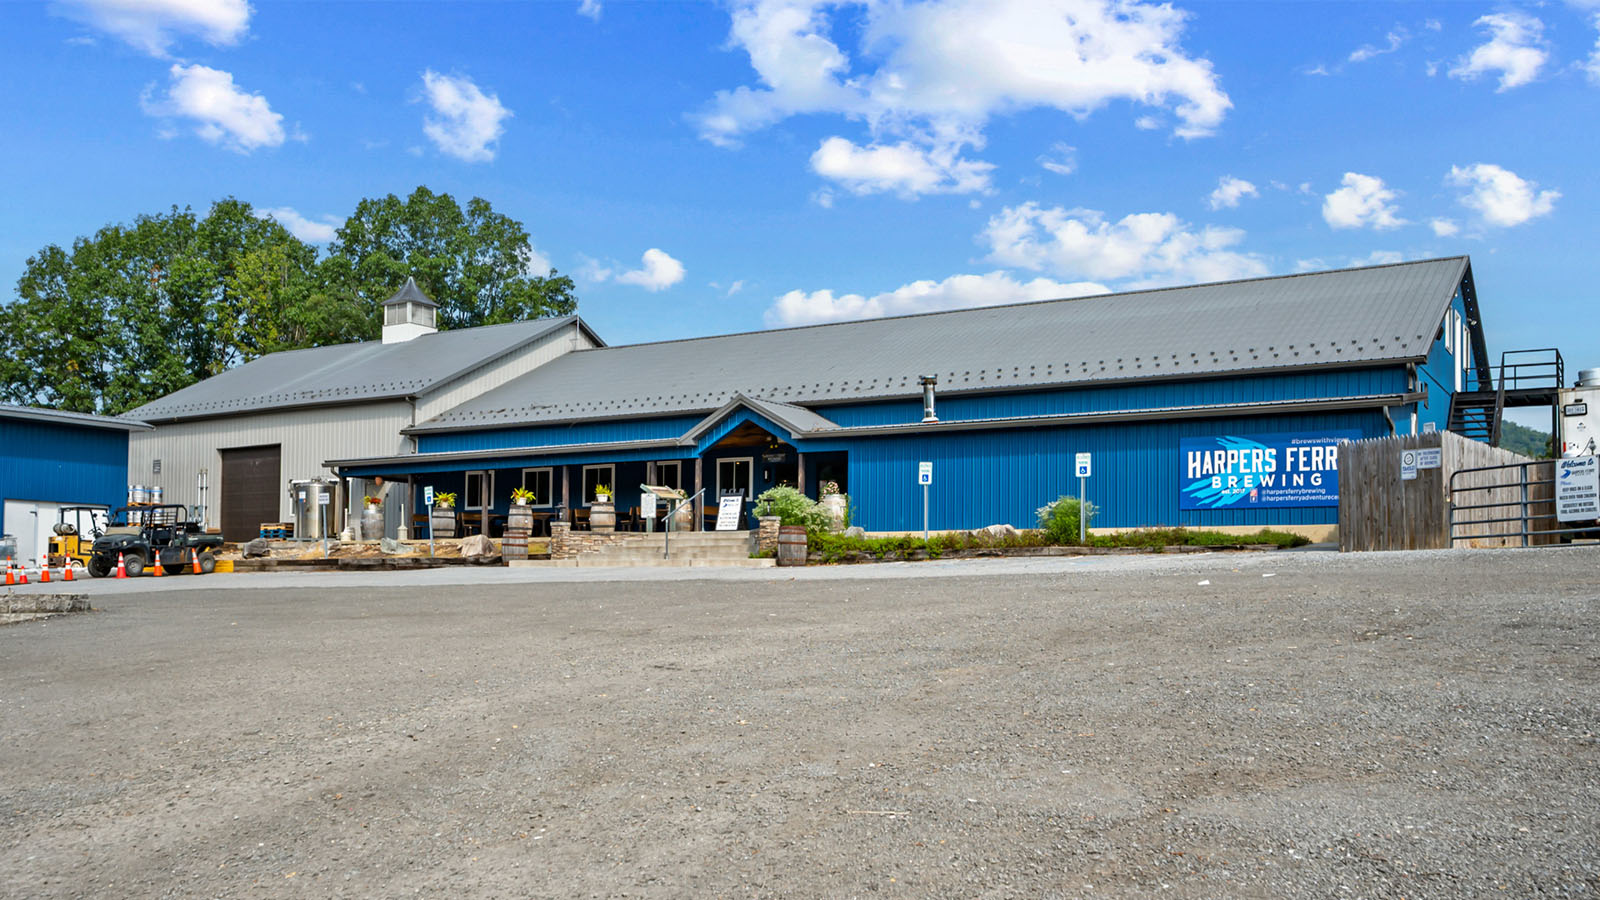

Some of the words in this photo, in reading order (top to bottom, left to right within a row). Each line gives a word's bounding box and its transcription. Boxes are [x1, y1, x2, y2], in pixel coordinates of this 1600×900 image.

[1187, 448, 1277, 479] HARPERS
[1286, 446, 1338, 471] FERR
[1212, 473, 1322, 488] BREWING
